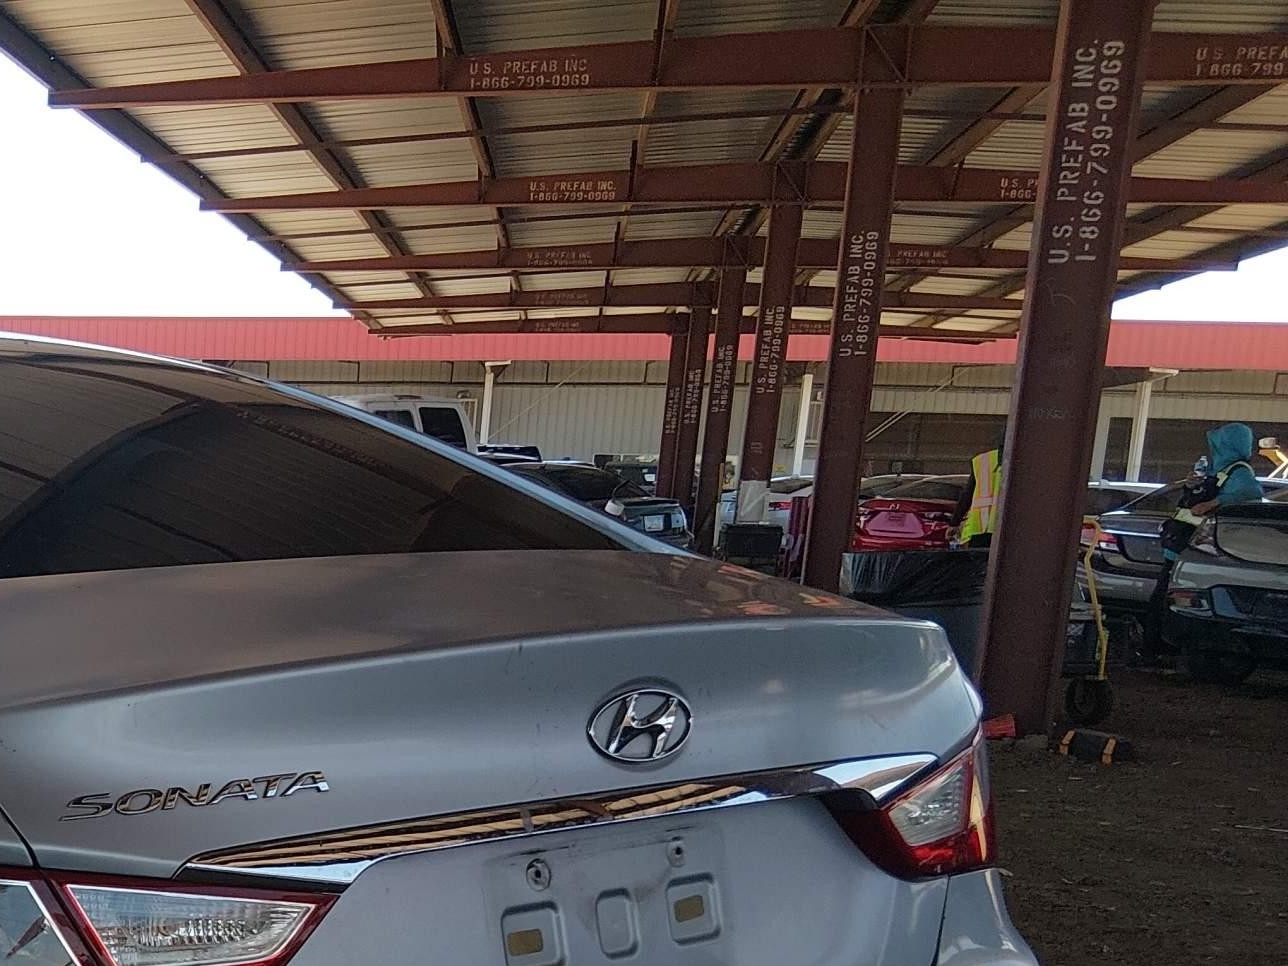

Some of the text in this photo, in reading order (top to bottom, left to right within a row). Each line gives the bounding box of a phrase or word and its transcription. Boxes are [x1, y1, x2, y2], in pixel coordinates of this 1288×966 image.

[470, 74, 590, 89] 1-866-799-0969
[503, 60, 557, 74] PREFAB
[1047, 39, 1099, 264] U.S. PREFAB INC.
[1075, 40, 1125, 261] 1-866-799-0969
[553, 181, 592, 191] PREFAB
[839, 230, 865, 357] U.S. PREFAB INC.
[854, 231, 879, 356] 1-866-799-0969
[759, 330, 772, 369] PREFAB
[58, 770, 330, 822] SONATA
